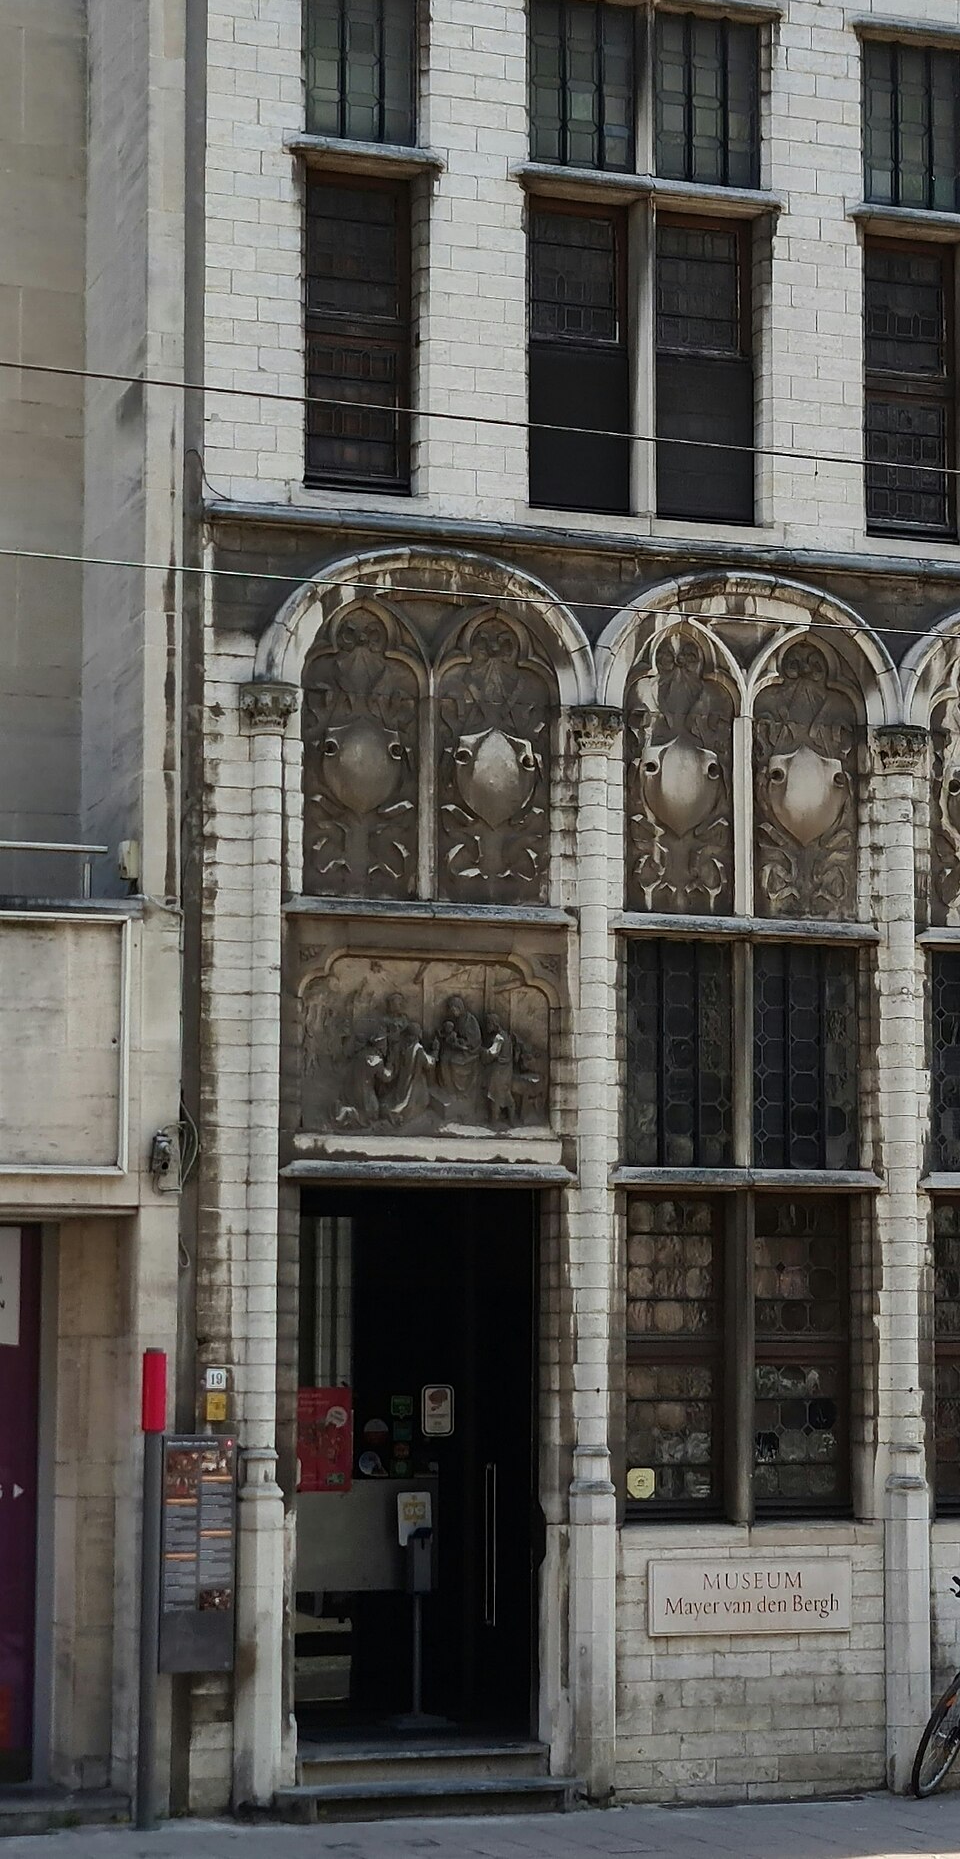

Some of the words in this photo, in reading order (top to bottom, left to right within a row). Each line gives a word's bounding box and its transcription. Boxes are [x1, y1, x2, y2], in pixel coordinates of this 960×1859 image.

[211, 1373, 222, 1385] 19
[703, 1571, 802, 1590] MUSEUM
[665, 1597, 720, 1621] Mayer
[724, 1600, 751, 1614] van
[757, 1595, 787, 1613] den
[792, 1593, 839, 1619] Bergh
